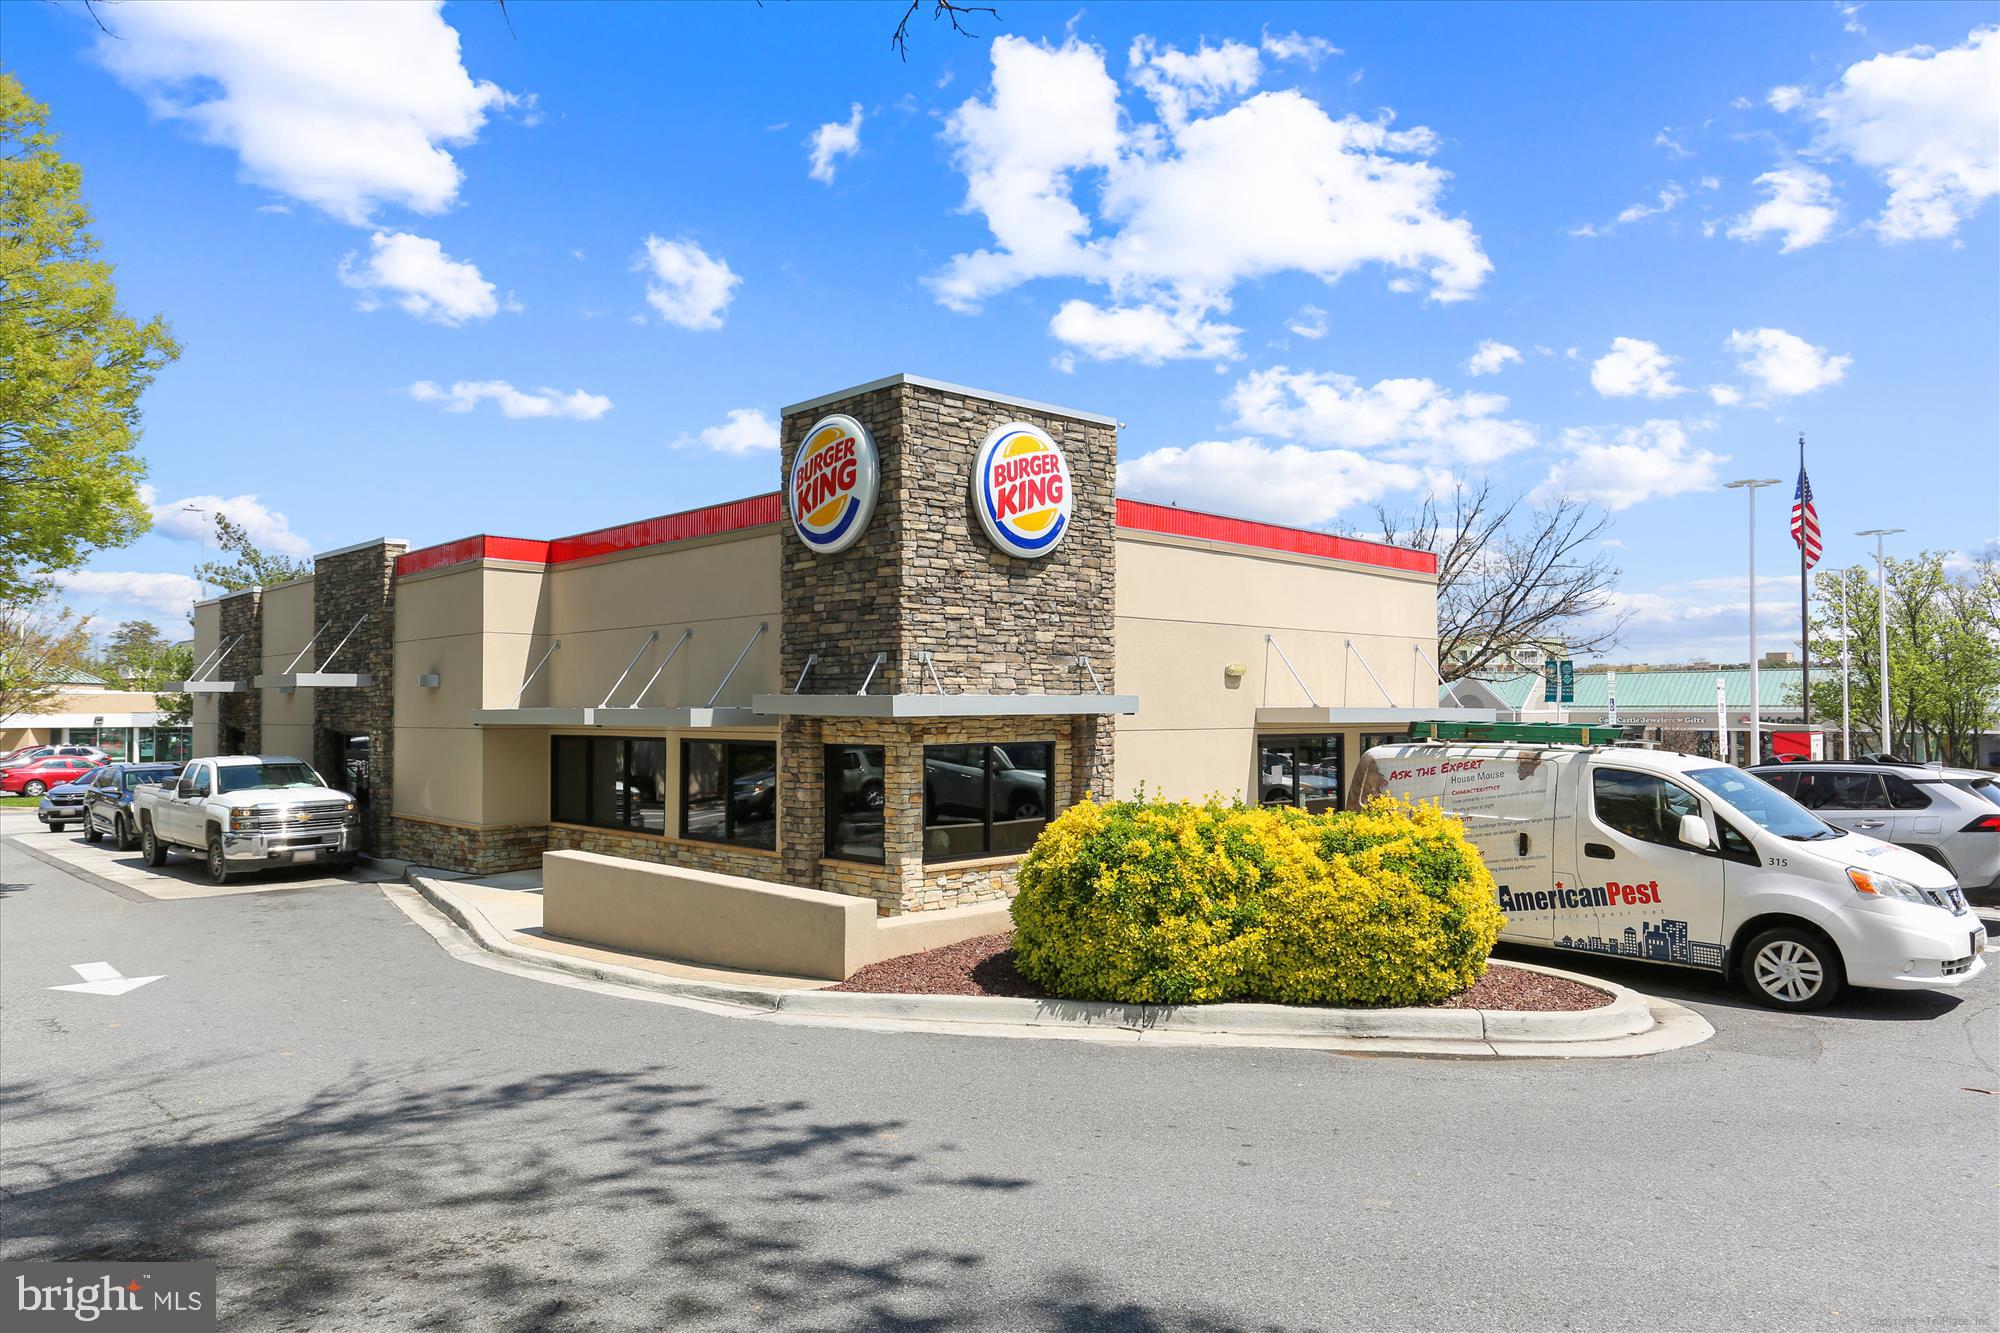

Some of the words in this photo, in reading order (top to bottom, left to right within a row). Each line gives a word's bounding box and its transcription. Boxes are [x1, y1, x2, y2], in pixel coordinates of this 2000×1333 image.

[796, 436, 855, 490] BURGER
[994, 453, 1059, 487] BURGER
[797, 458, 857, 522] KING
[996, 474, 1063, 521] KING
[1684, 716, 1705, 724] Gifts
[1451, 775, 1475, 784] House
[1478, 770, 1505, 781] Mouse
[1768, 857, 1788, 867] 315
